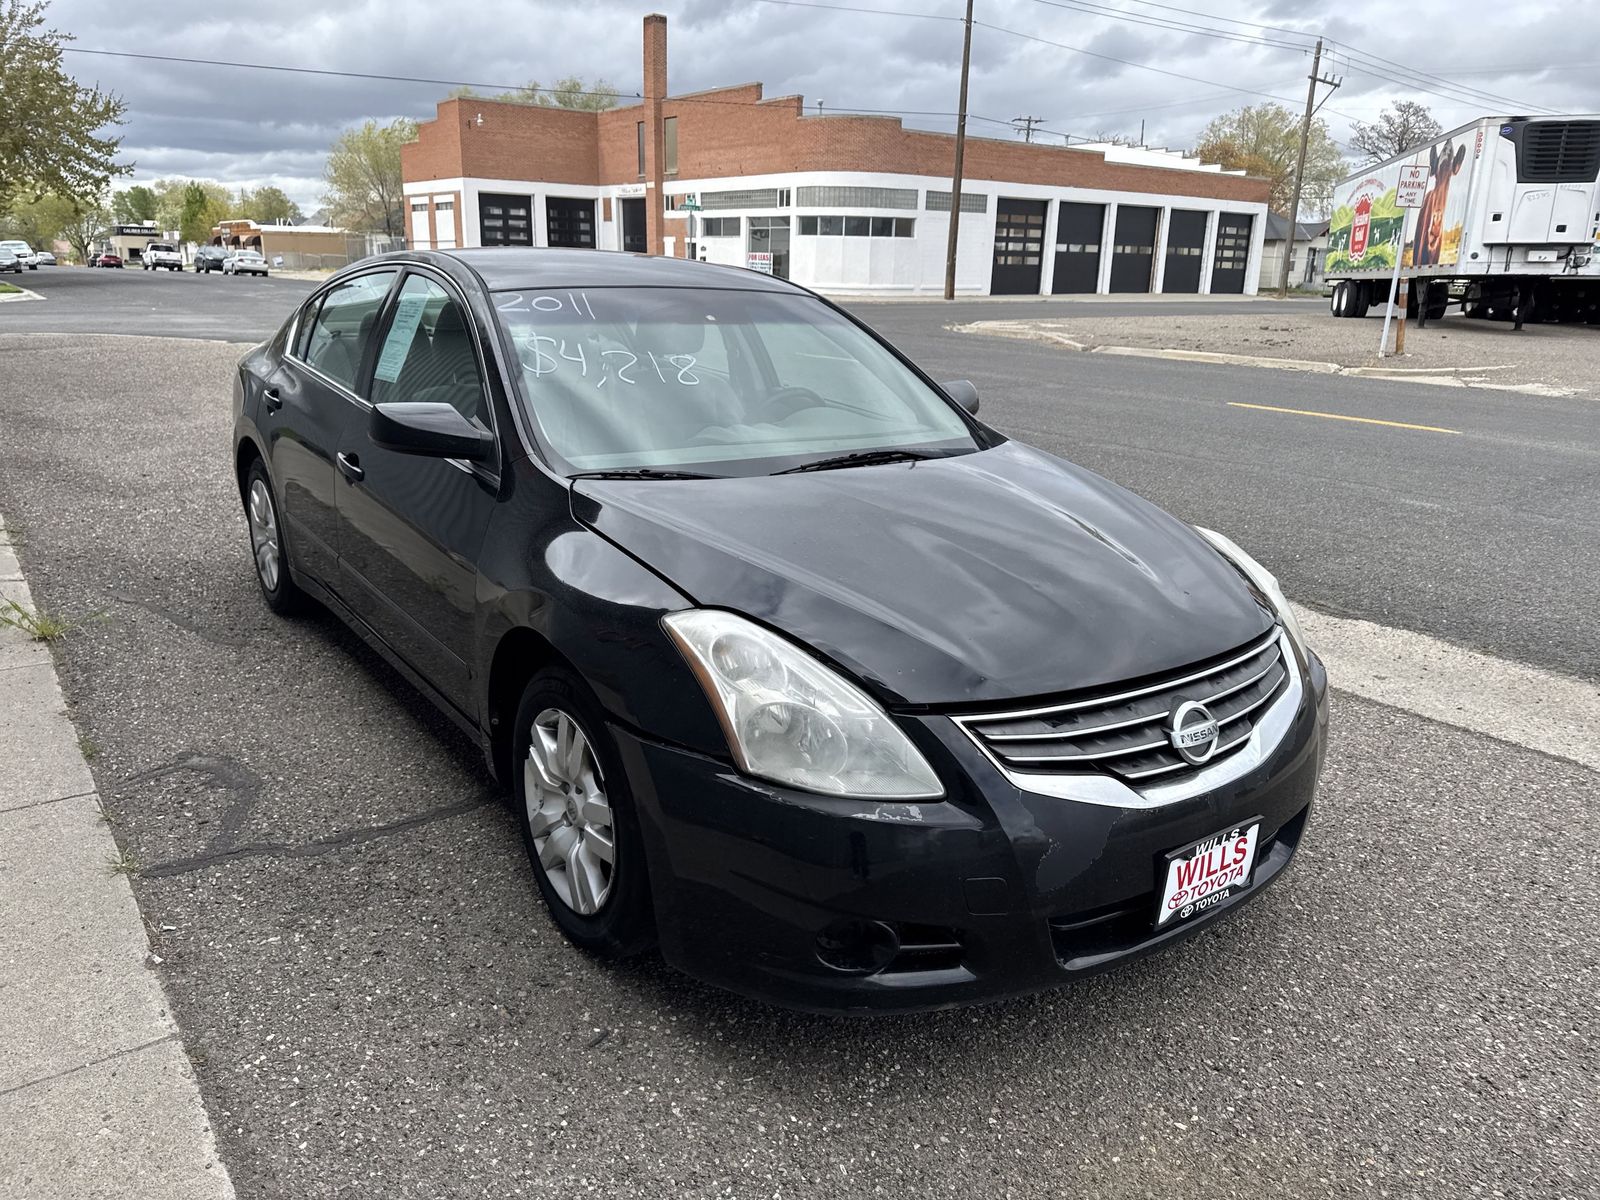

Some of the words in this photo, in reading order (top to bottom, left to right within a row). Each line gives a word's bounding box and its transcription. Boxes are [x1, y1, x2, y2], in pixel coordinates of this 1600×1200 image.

[1400, 180, 1426, 190] PARKING
[1409, 170, 1420, 179] NO
[748, 253, 757, 261] FOR
[496, 292, 596, 319] 2011
[522, 331, 700, 389] $4,218
[1180, 723, 1218, 744] NISSAN
[1195, 828, 1240, 856] WILLS
[1176, 837, 1248, 890] WILLS
[1190, 865, 1243, 900] TOYOTA
[1195, 889, 1230, 911] TOYOTA
